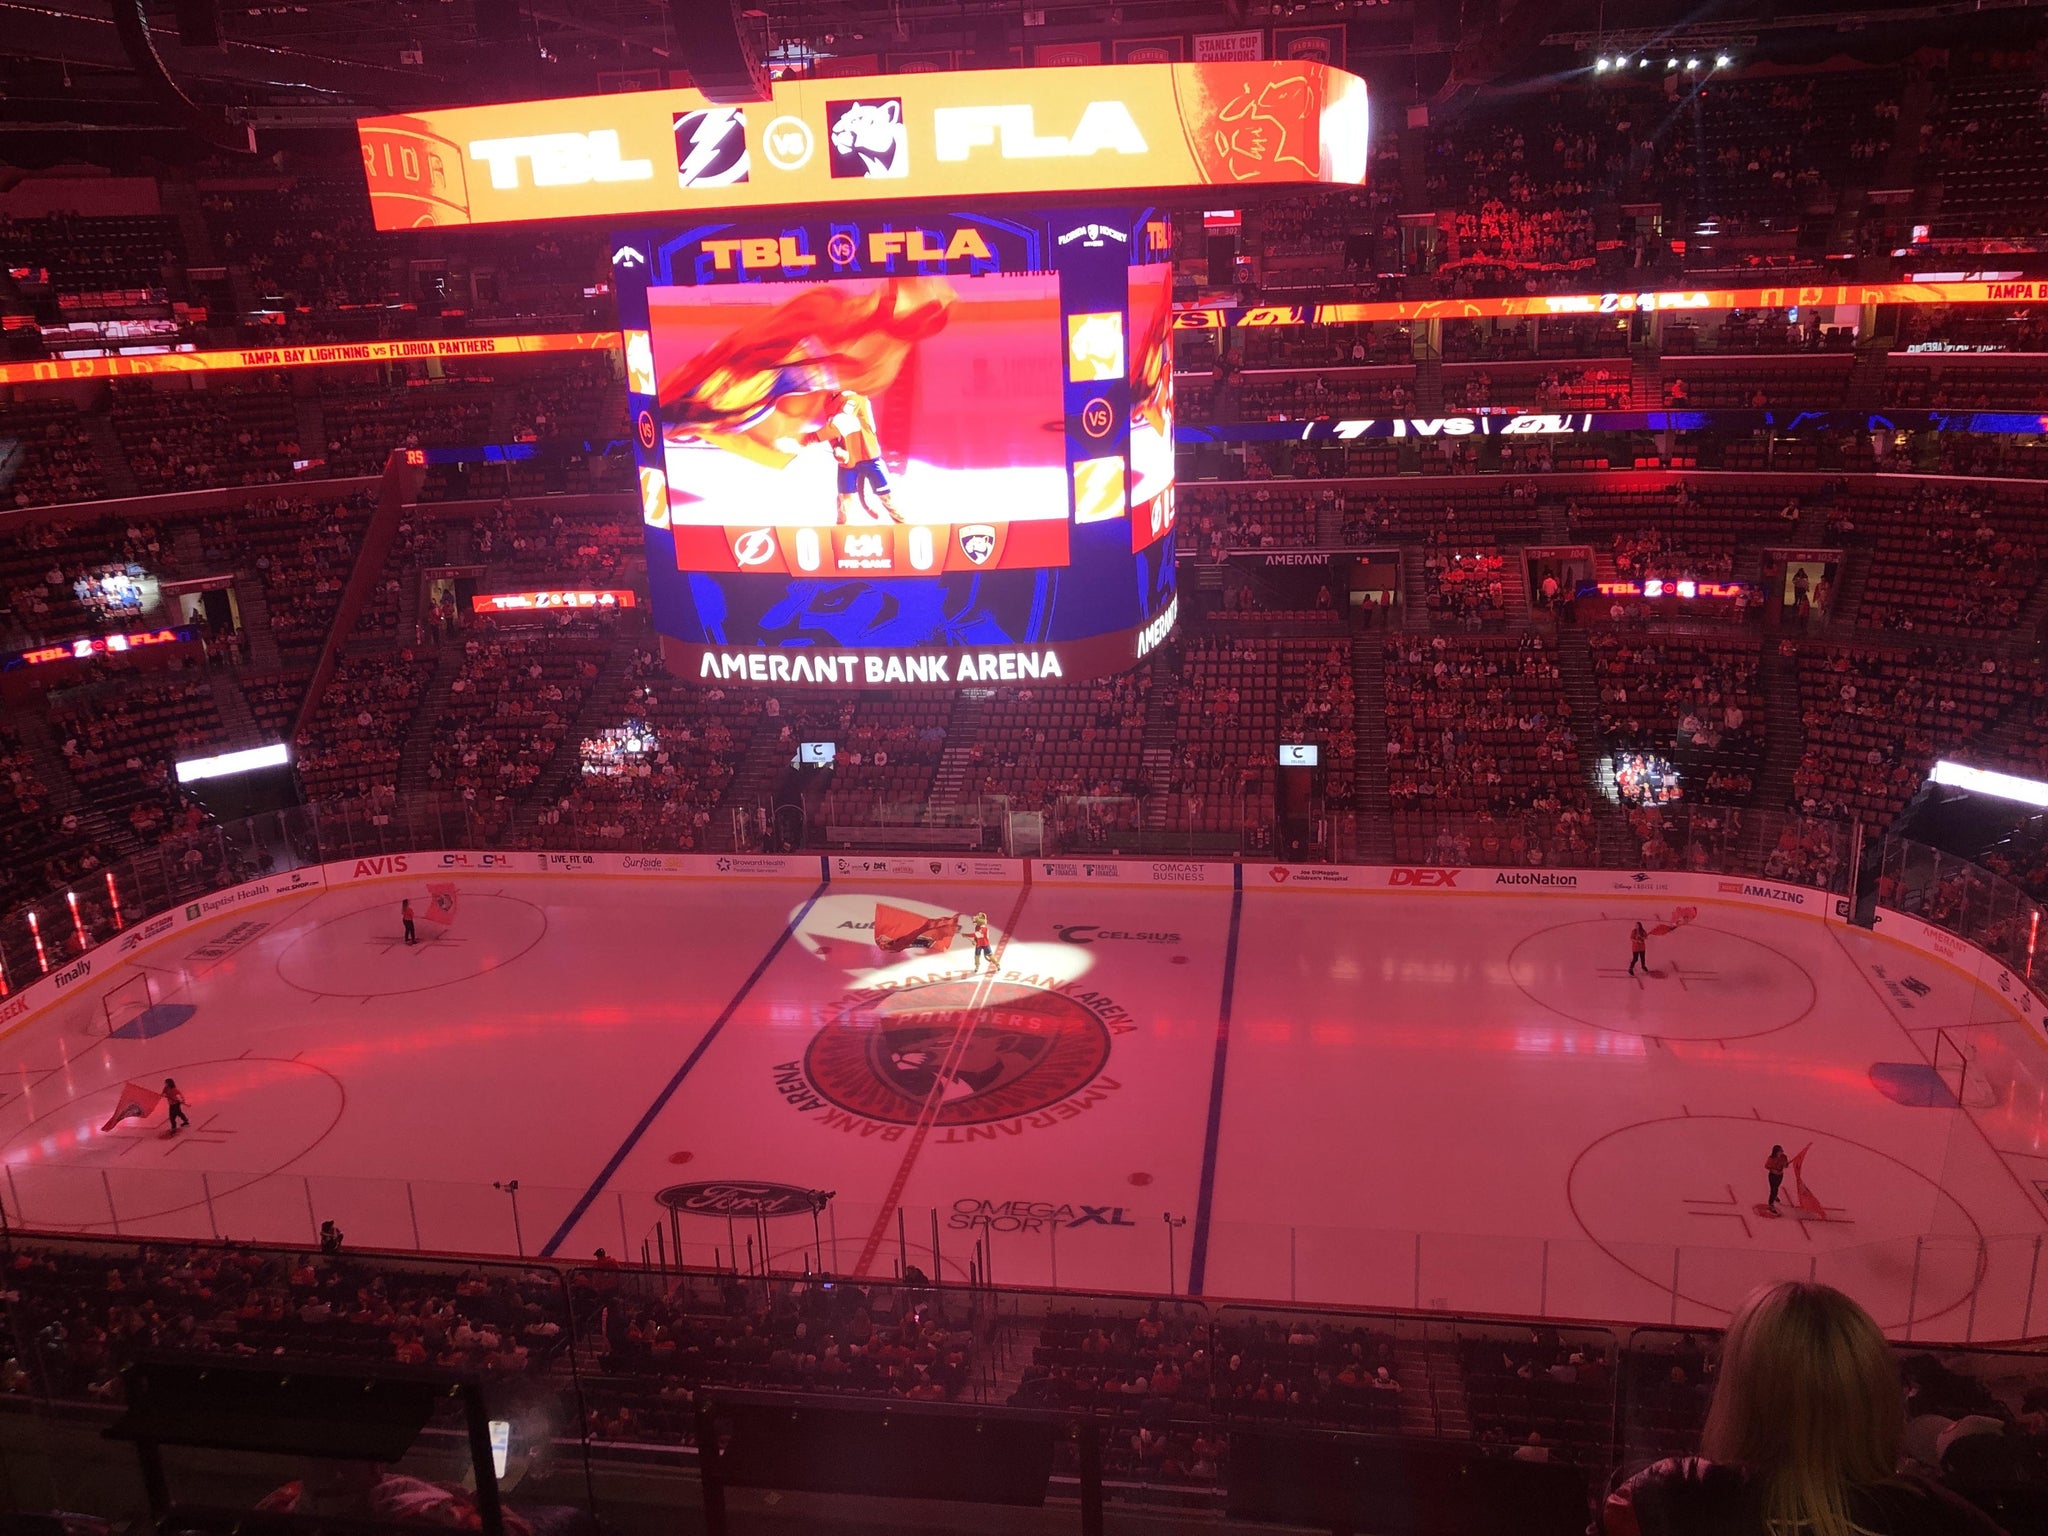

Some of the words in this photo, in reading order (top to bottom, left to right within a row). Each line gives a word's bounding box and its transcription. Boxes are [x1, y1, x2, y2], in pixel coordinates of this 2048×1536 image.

[1199, 39, 1238, 53] STANLEY
[1240, 37, 1258, 50] CUP
[934, 101, 1149, 161] FLA
[470, 129, 653, 189] TBL
[701, 237, 816, 270] TBL
[833, 243, 851, 257] VS
[869, 229, 991, 264] FLA
[1987, 285, 2033, 299] TAMPA
[240, 352, 281, 366] TAMPA
[283, 350, 306, 363] BAY
[309, 345, 370, 361] LIGHTNING
[373, 346, 387, 355] VS
[390, 342, 436, 357] FLORIDA
[438, 339, 495, 354] PANTHERS
[1089, 410, 1107, 427] VS
[1411, 417, 1475, 436] VS
[795, 527, 821, 571] 0
[908, 526, 934, 570] 0
[1265, 554, 1330, 566] AMERANT
[1598, 583, 1641, 596] TBL
[22, 647, 72, 664] TBL
[128, 630, 177, 646] FLA
[700, 651, 858, 683] AMERANT
[864, 655, 948, 683] BANK
[957, 651, 1062, 681] ARENA
[353, 855, 408, 878] AVIS
[623, 856, 662, 868] Surfside
[1152, 863, 1205, 873] COMCAST
[1153, 872, 1205, 881] BUSINESS
[1388, 868, 1462, 887] DEX
[1495, 873, 1577, 885] AutoNation
[202, 896, 235, 912] Baptist
[237, 884, 270, 900] Health
[1743, 885, 1805, 904] AMAZING
[1098, 931, 1182, 940] CELSIUS
[1922, 926, 1969, 953] AMERANT
[54, 959, 91, 988] finally
[1074, 991, 1138, 1035] ARENA
[772, 1060, 828, 1112] ARENA
[686, 1185, 793, 1214] Ford
[953, 1198, 1076, 1219] OMEGA
[1066, 1205, 1136, 1228] XL
